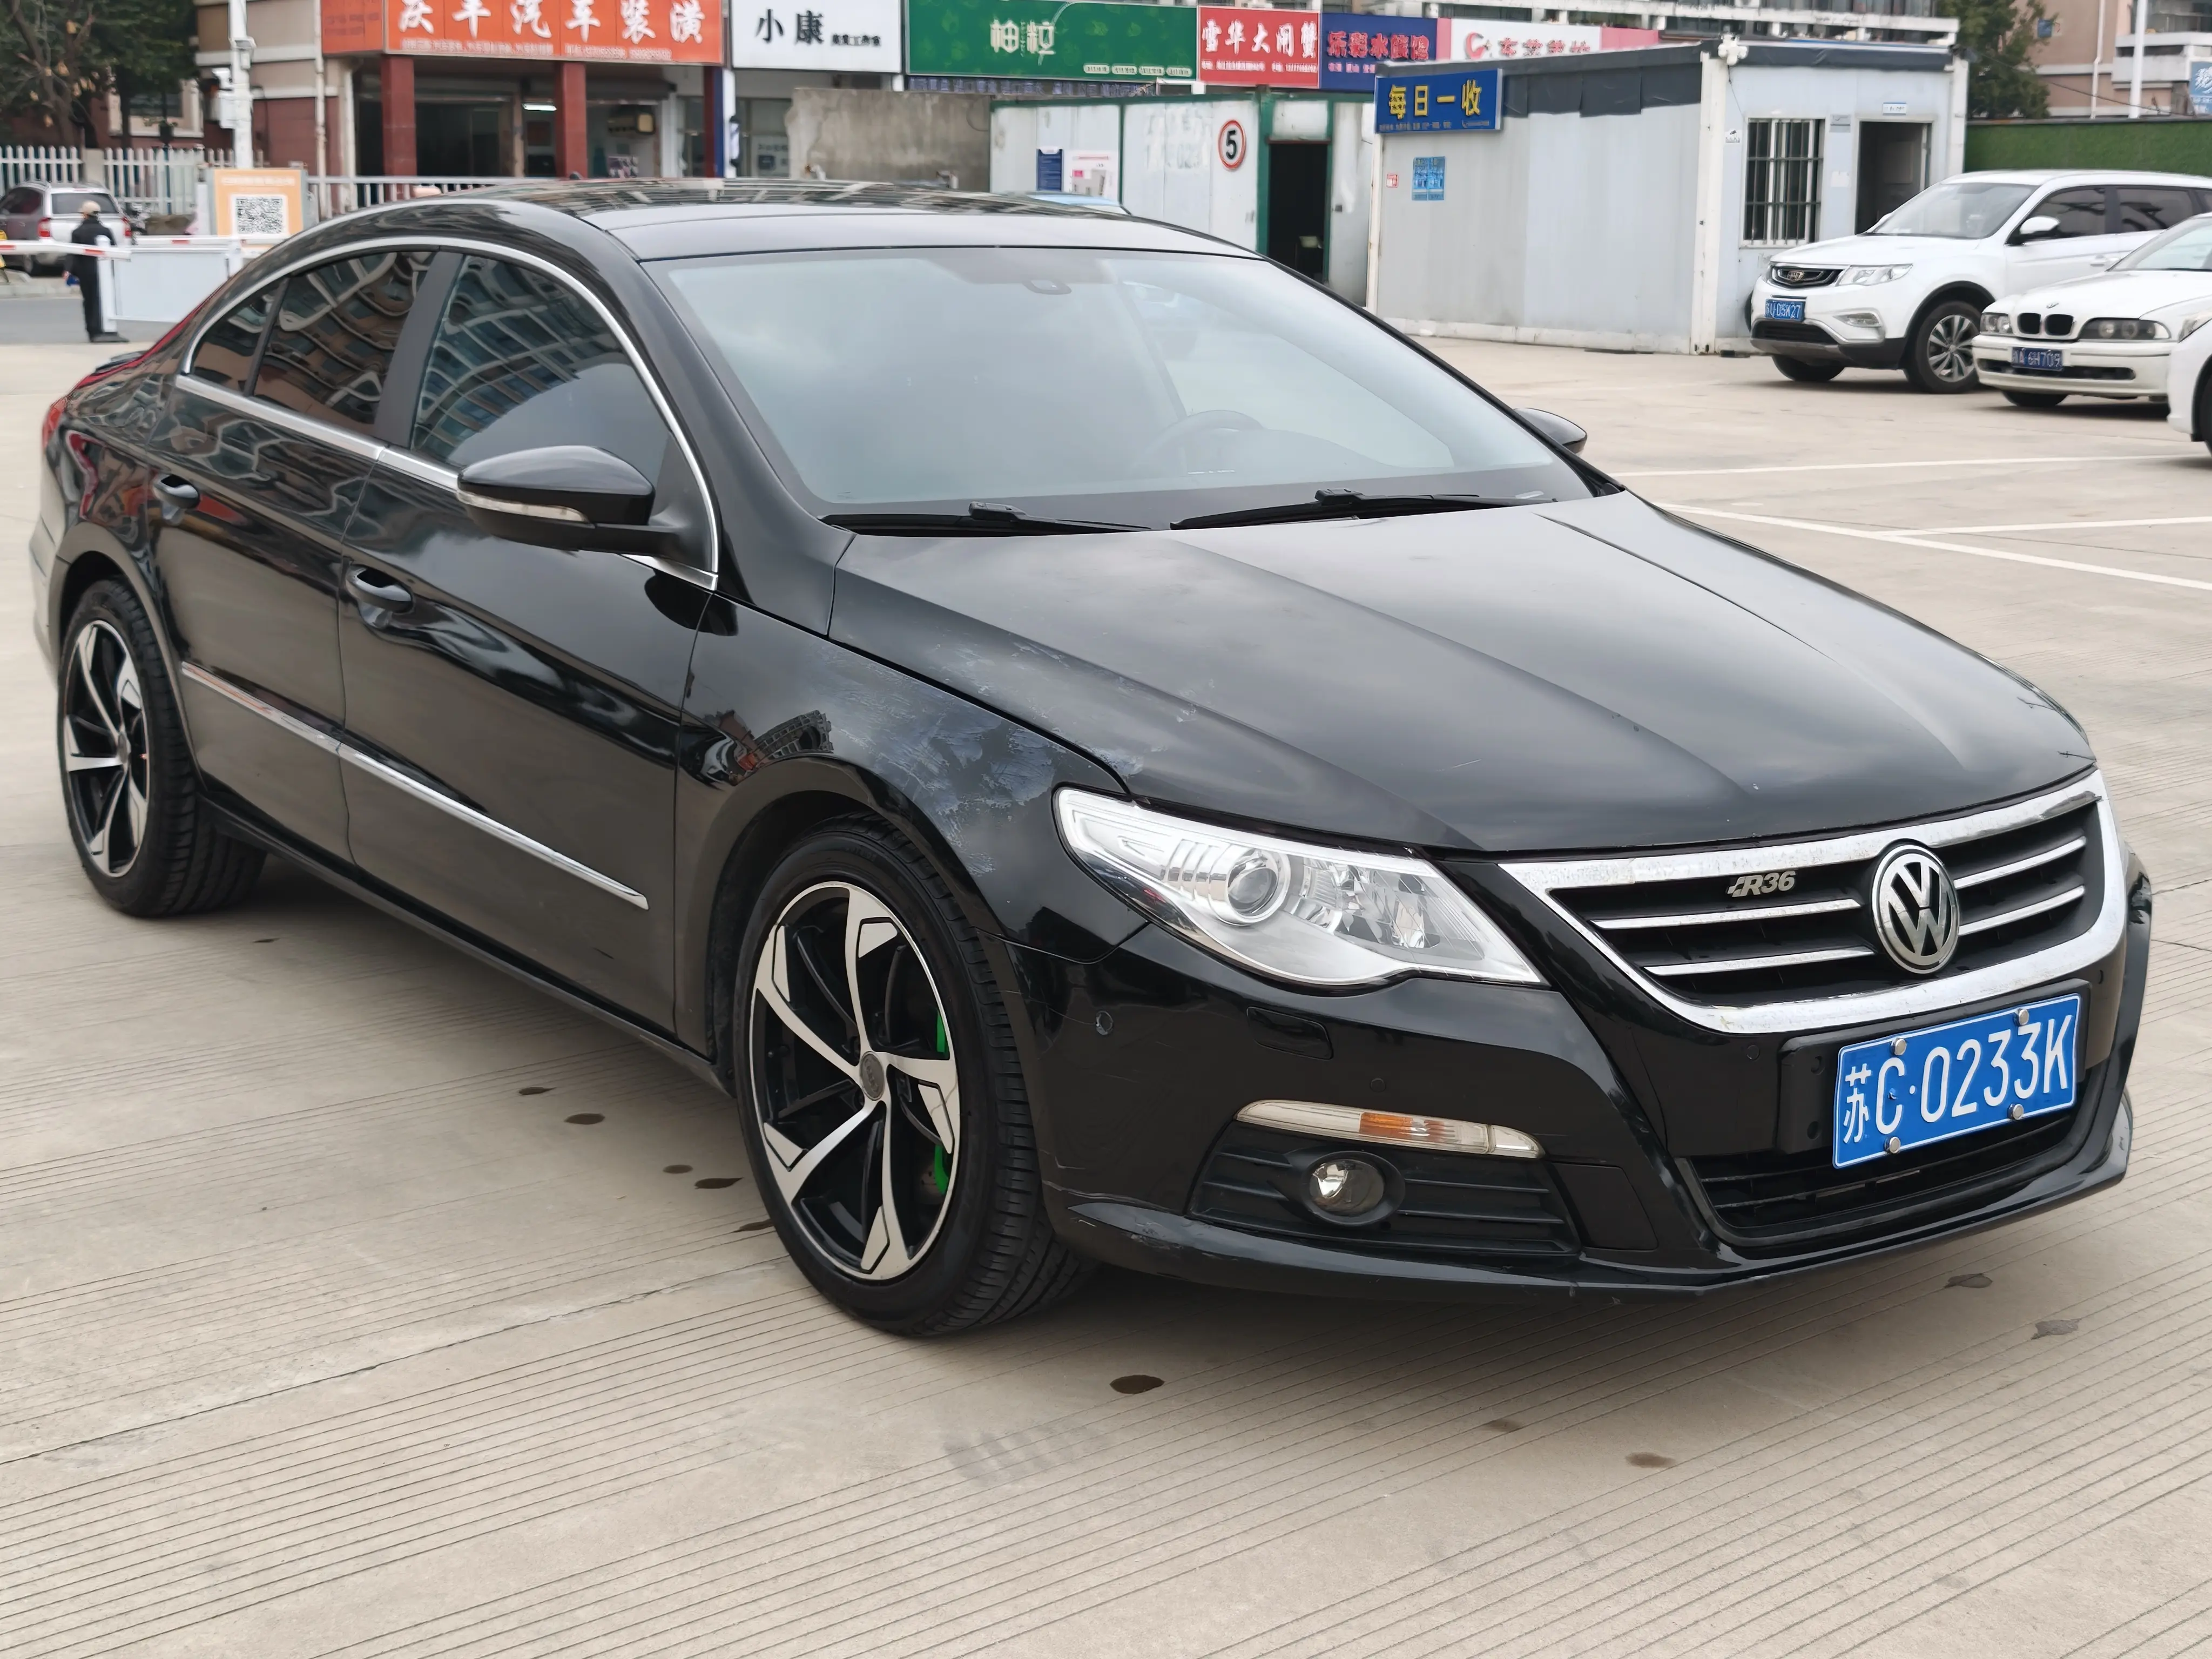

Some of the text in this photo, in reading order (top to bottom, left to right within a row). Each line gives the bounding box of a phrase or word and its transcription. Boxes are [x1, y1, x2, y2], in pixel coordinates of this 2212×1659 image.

[755, 9, 824, 44] 小康
[1388, 79, 1482, 120] 每日一收
[1225, 130, 1237, 160] 5
[1731, 871, 1796, 897] R36
